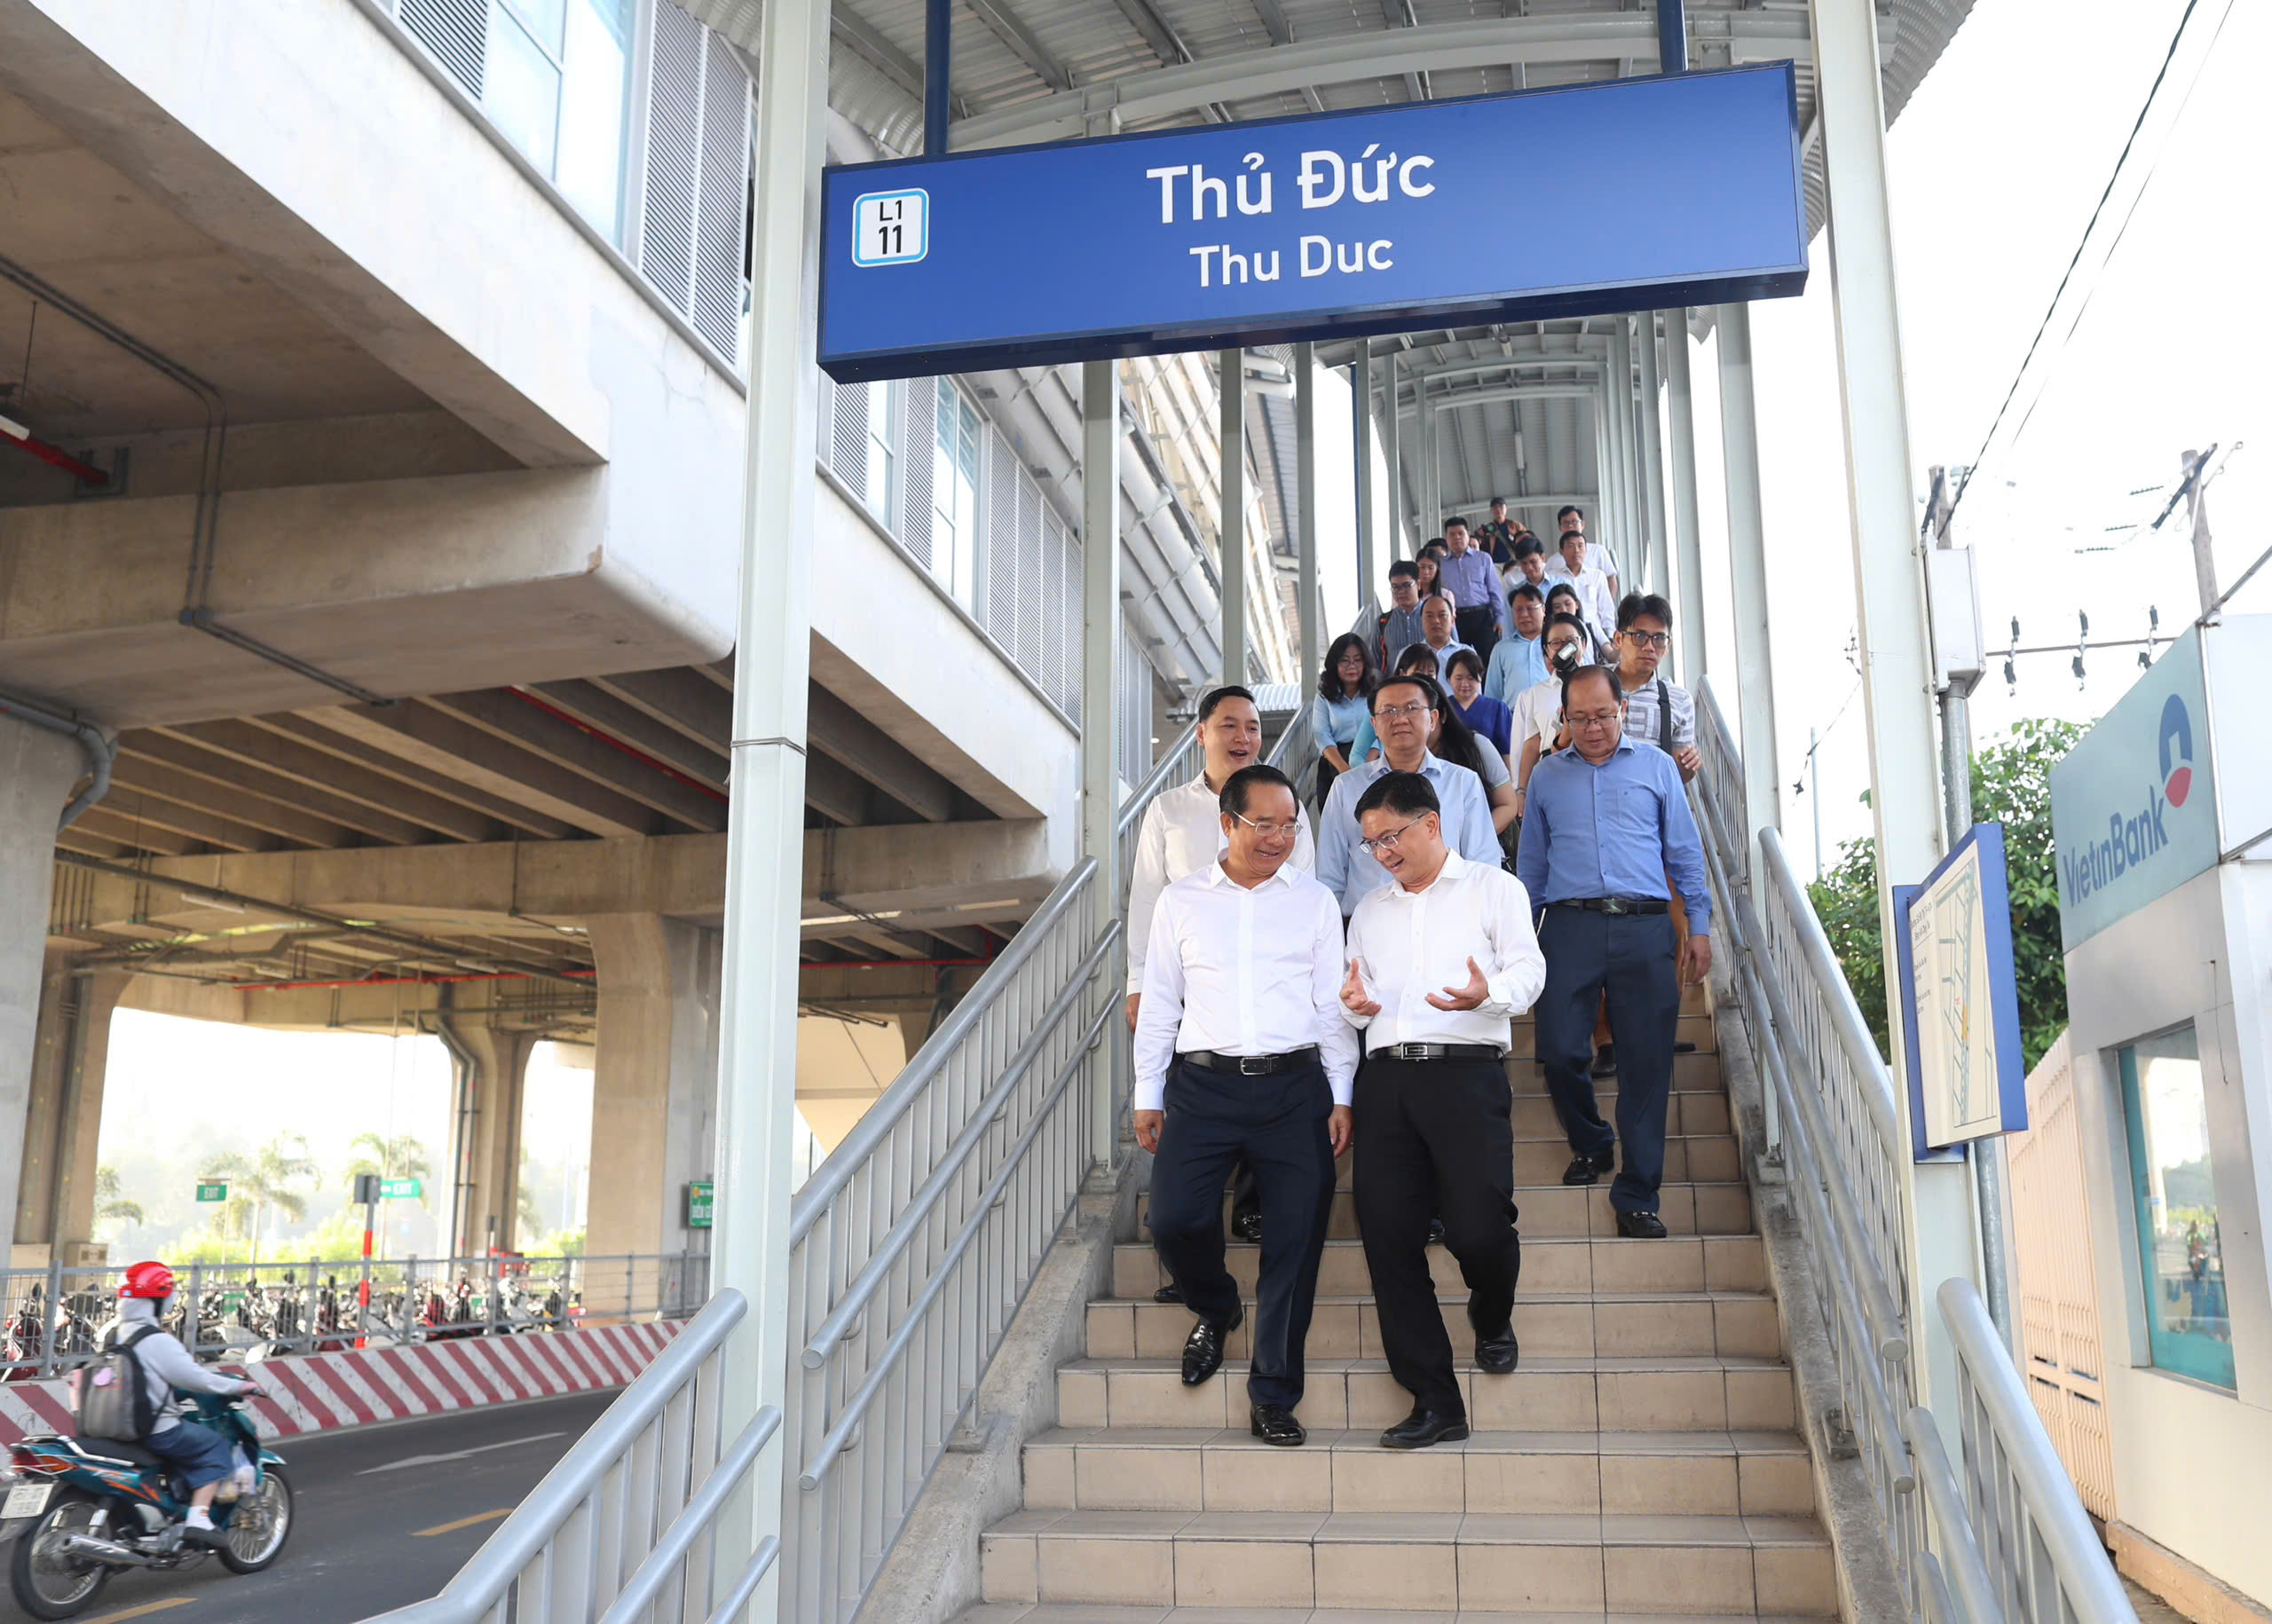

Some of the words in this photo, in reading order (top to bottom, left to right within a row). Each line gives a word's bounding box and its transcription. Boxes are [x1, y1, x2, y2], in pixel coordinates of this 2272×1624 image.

[879, 200, 902, 221] L1
[1147, 152, 1272, 224] Thủ
[1297, 143, 1436, 209] Đức
[879, 225, 902, 255] 11
[1189, 244, 1280, 288] Thu
[1299, 234, 1394, 278] Duc
[2063, 784, 2168, 908] VietinBank
